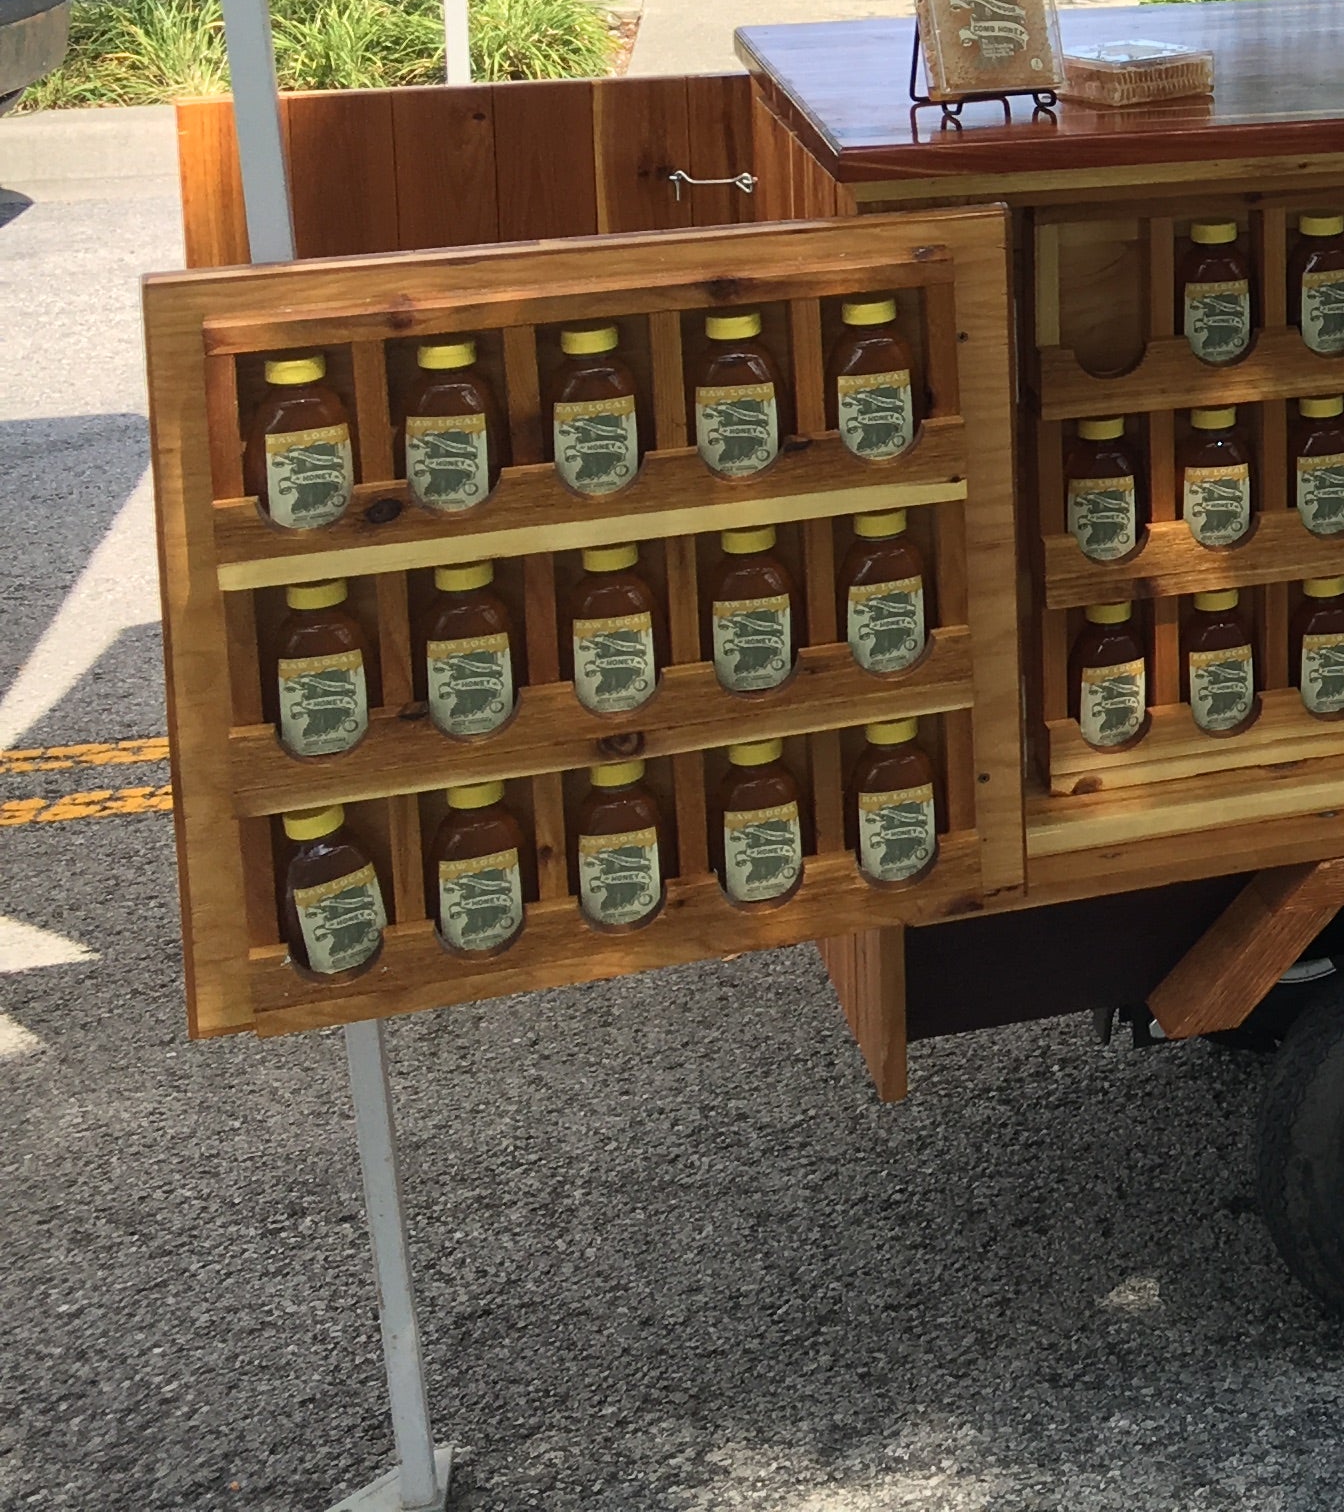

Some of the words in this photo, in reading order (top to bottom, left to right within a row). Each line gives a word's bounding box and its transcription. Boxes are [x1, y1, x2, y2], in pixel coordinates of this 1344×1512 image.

[973, 24, 996, 33] COMB
[997, 25, 1025, 37] HONEY
[839, 377, 865, 387] RAW
[869, 374, 906, 384] LOCAL
[700, 389, 727, 397] RAW
[730, 386, 771, 397] LOCAL
[556, 405, 583, 415] RAW
[588, 400, 627, 412] LOCAL
[867, 414, 895, 423] HONEY
[729, 426, 758, 435] HONEY
[586, 443, 616, 451] HONEY
[434, 460, 466, 469] HONEY
[302, 472, 333, 483] HONEY
[576, 620, 602, 630] RAW
[608, 616, 649, 628] LOCAL
[430, 641, 456, 651] RAW
[463, 635, 507, 648] LOCAL
[279, 660, 308, 671] RAW
[313, 654, 357, 667] LOCAL
[606, 658, 636, 667] HONEY
[461, 679, 491, 688] HONEY
[313, 698, 345, 707] HONEY
[861, 794, 889, 804] RAW
[893, 788, 930, 801] LOCAL
[757, 847, 785, 856] HONEY
[610, 873, 640, 882] HONEY
[471, 897, 501, 907] HONEY
[336, 912, 366, 926] HONEY
